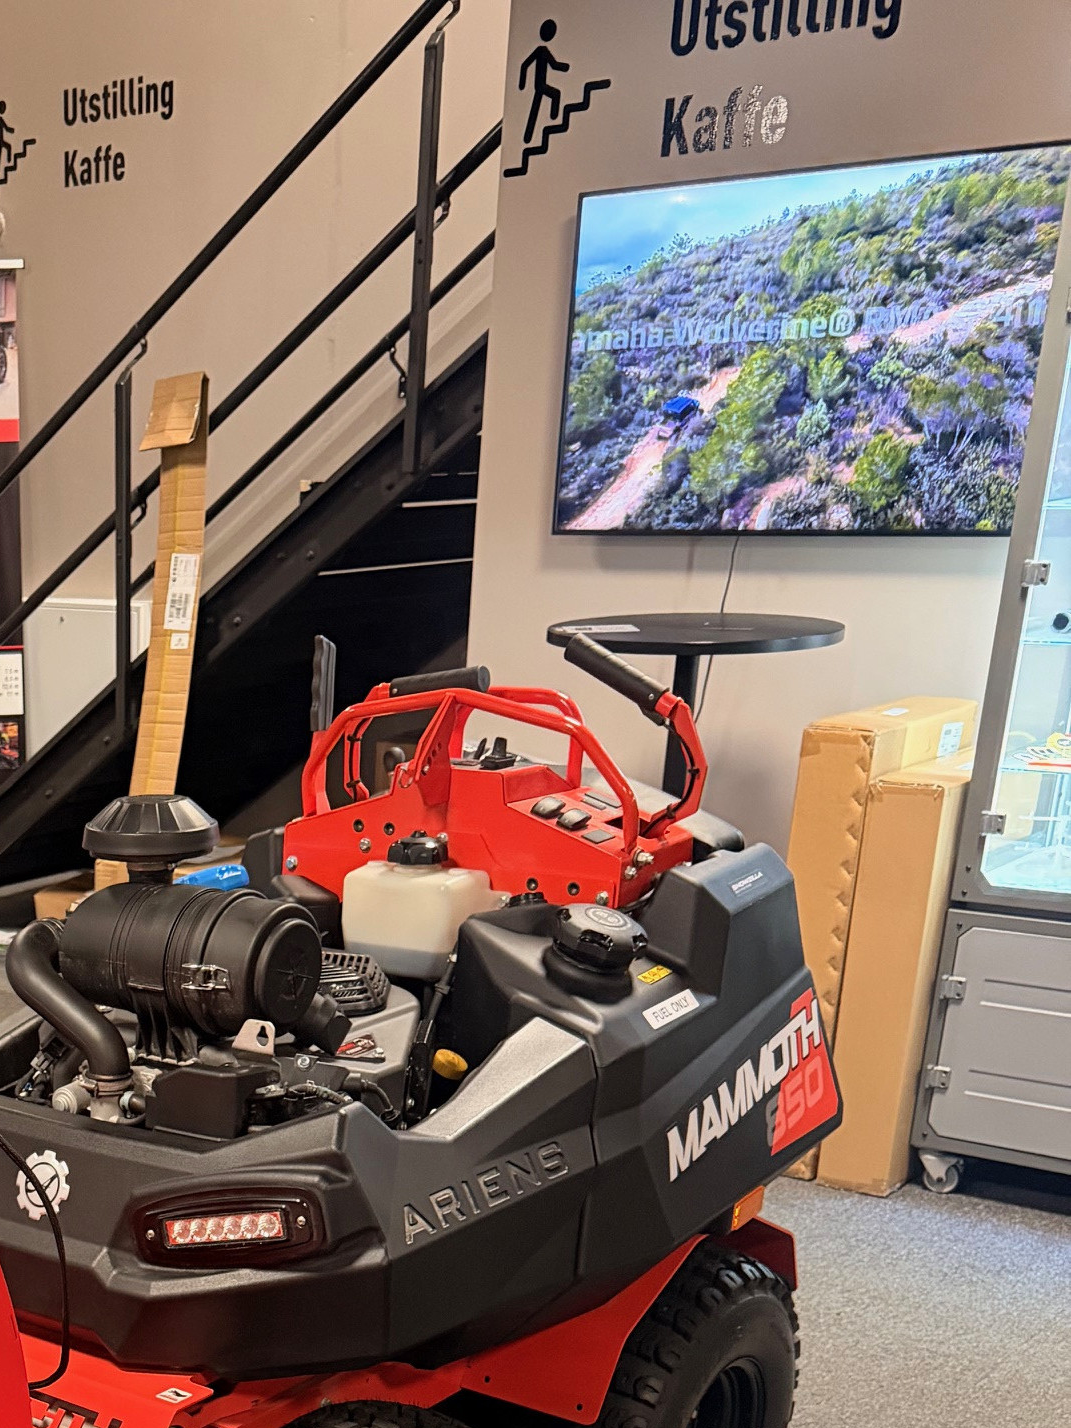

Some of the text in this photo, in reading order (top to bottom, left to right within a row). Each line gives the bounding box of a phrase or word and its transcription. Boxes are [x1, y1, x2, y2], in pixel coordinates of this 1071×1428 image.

[63, 75, 174, 126] Utstilling
[660, 84, 789, 158] Kaffe
[64, 144, 126, 188] Kaffe
[652, 995, 690, 1023] FUEL ONLY
[666, 1001, 821, 1182] MAMMOTH
[765, 1054, 824, 1147] 850
[403, 1141, 569, 1245] ARIENS
